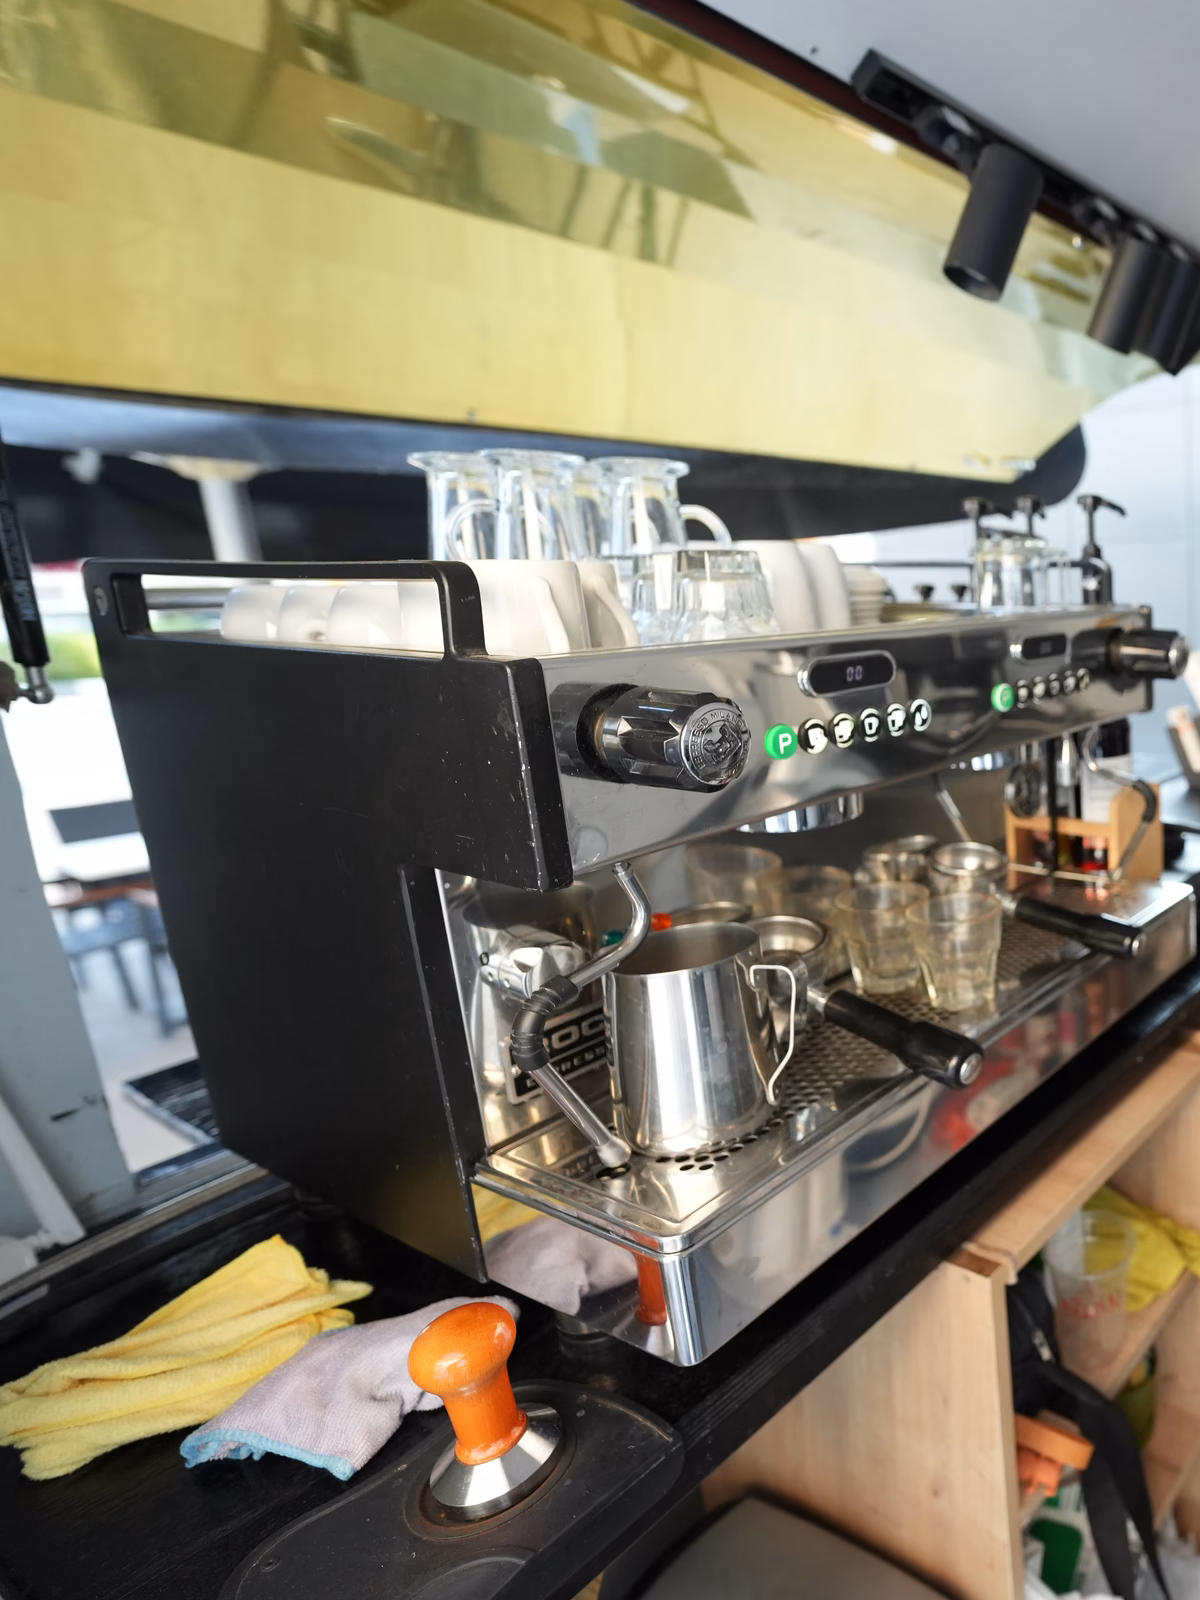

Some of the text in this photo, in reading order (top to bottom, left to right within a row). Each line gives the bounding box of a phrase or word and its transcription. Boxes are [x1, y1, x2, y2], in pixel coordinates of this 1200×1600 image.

[846, 665, 863, 682] 00
[710, 712, 745, 728] MILANO
[778, 733, 792, 755] P
